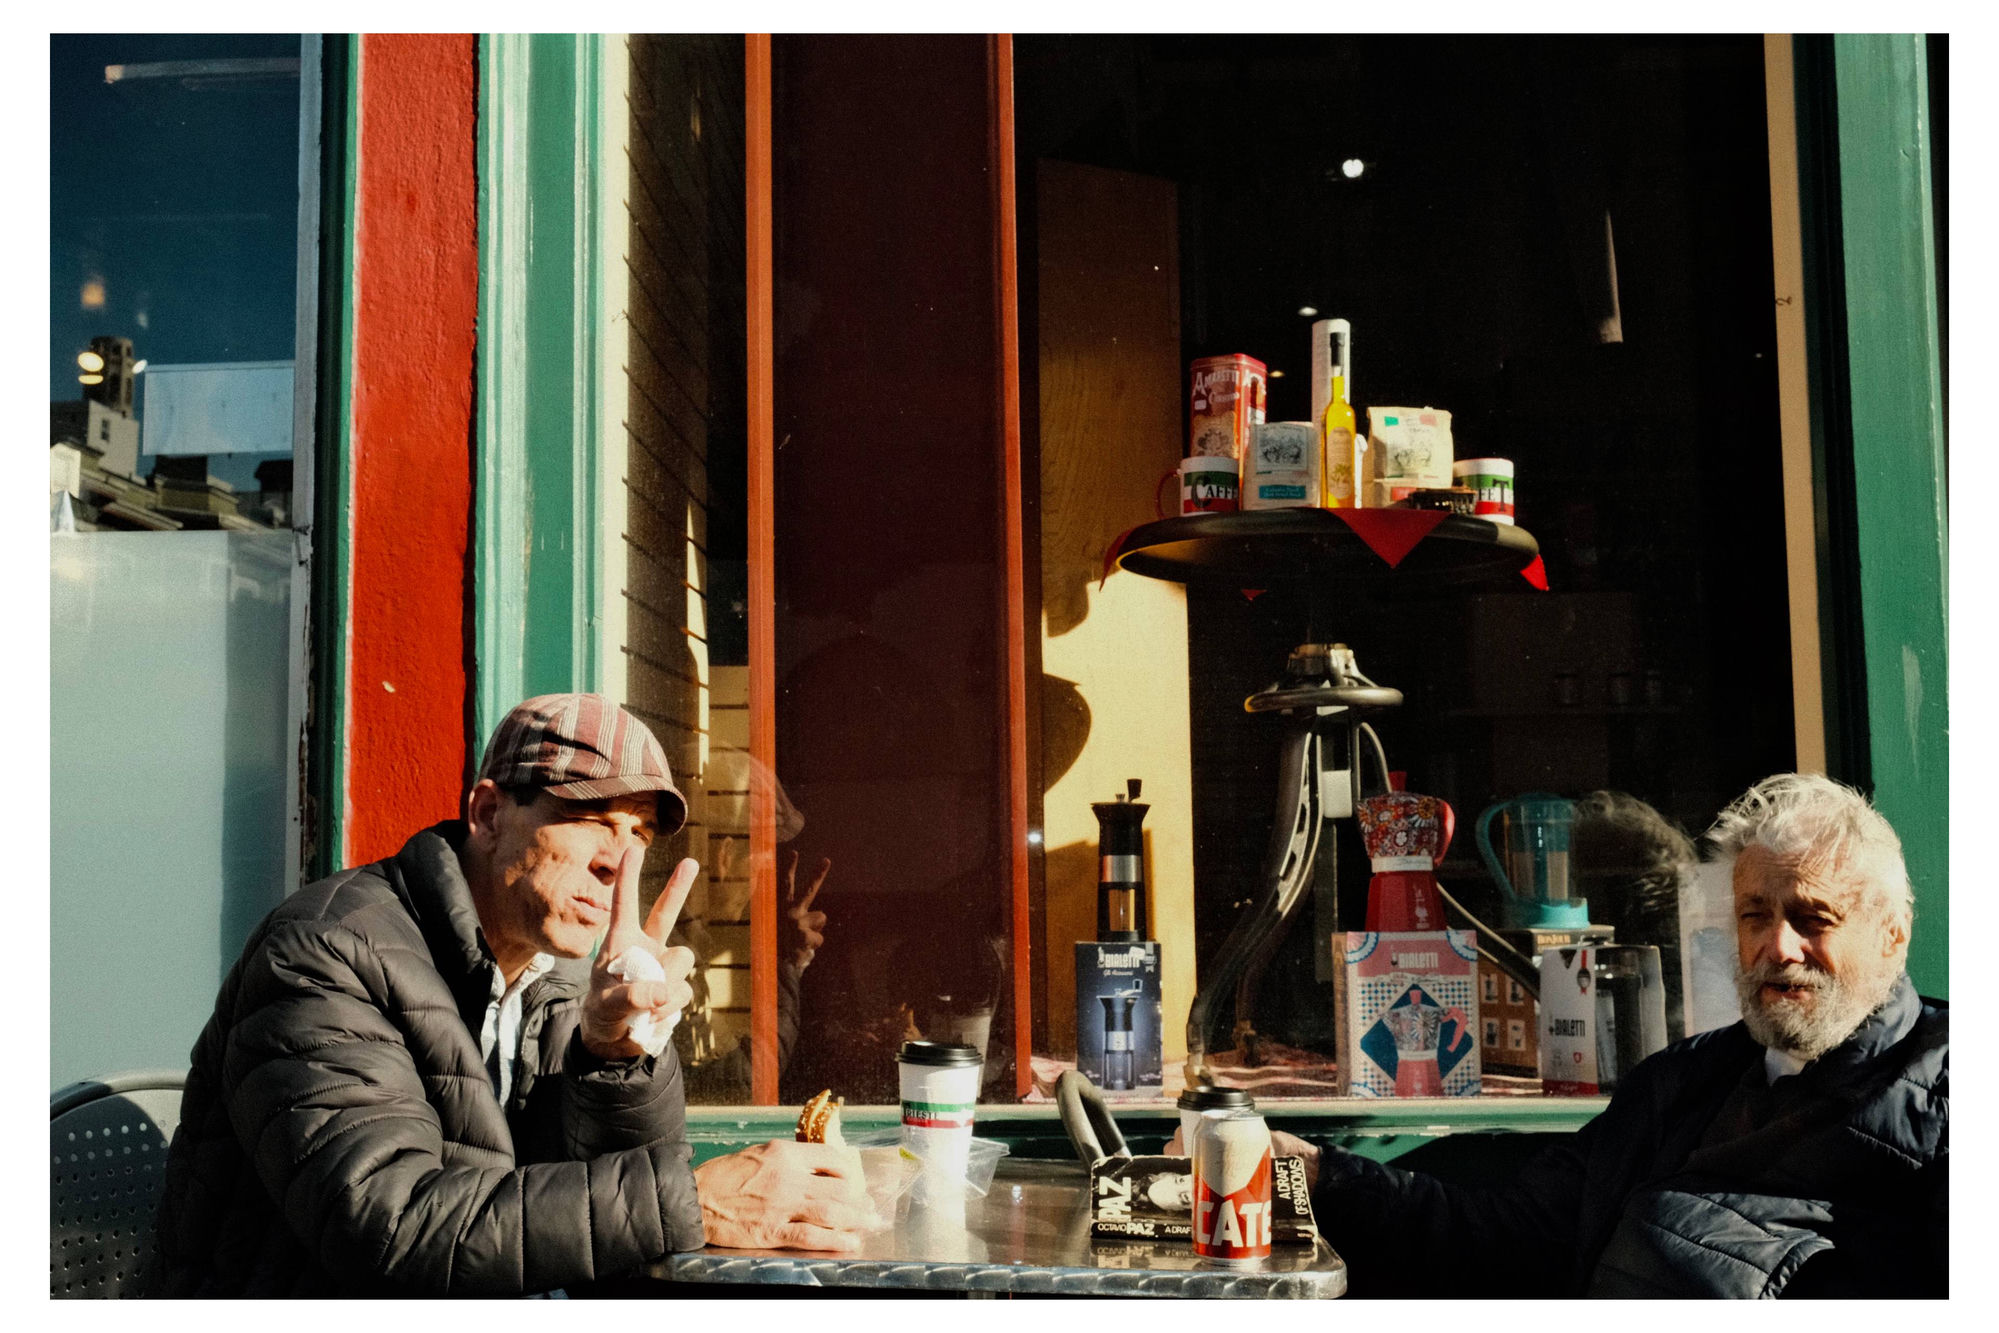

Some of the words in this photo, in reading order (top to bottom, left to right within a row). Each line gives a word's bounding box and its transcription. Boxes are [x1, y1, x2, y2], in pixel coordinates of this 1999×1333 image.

[1399, 952, 1438, 968] BIALETTI
[1555, 1019, 1585, 1036] BIALETTI
[1275, 1160, 1291, 1192] DRAFT
[1289, 1159, 1307, 1206] SHADOWS
[1098, 1176, 1132, 1222] PAZ
[1098, 1223, 1127, 1232] OCTAVIO
[1171, 1225, 1192, 1235] DRAF
